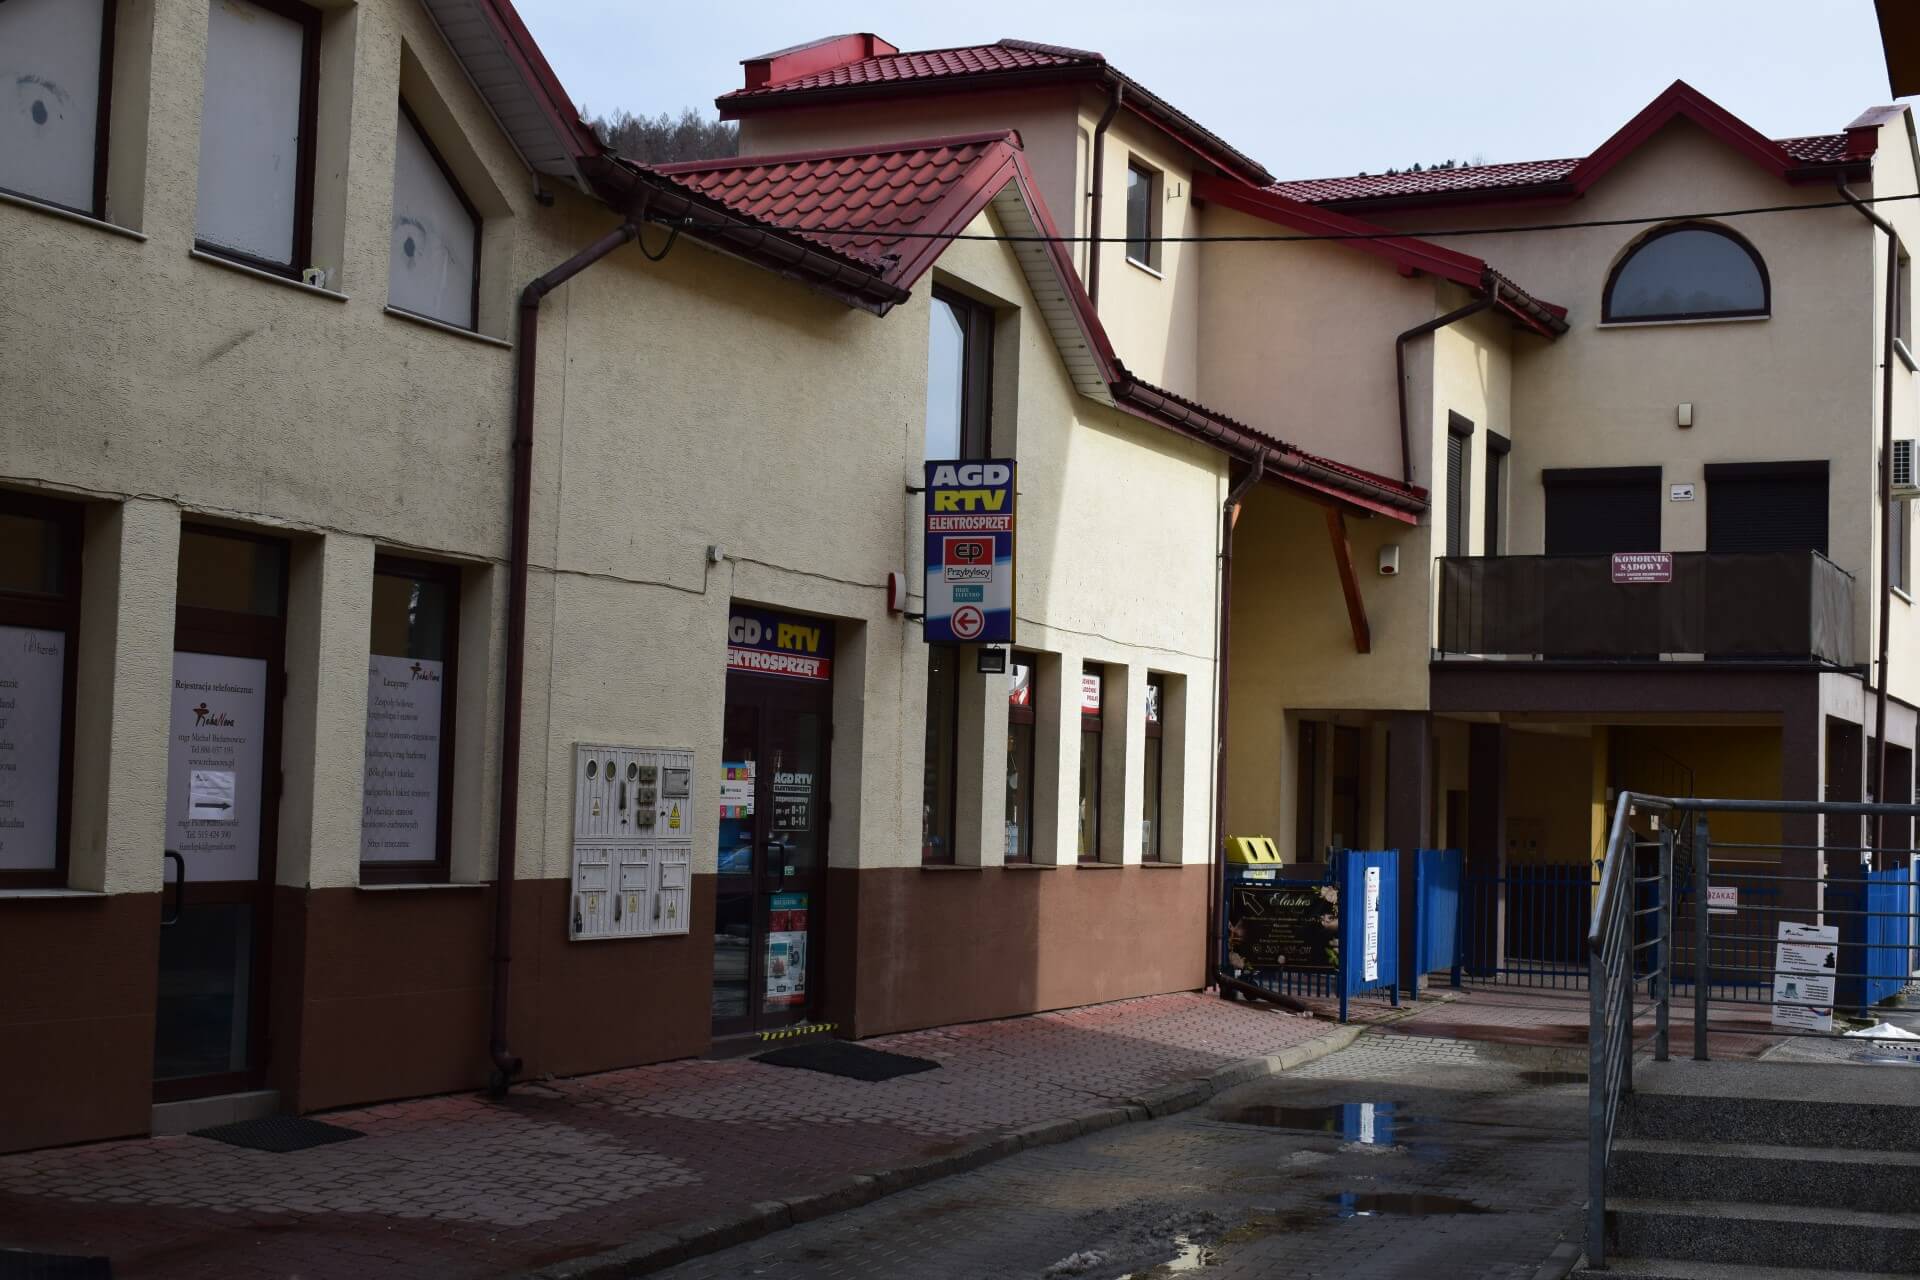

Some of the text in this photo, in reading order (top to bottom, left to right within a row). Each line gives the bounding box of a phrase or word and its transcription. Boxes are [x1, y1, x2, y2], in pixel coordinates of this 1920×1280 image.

[931, 464, 1010, 487] AGD
[934, 489, 1007, 512] RTV
[929, 516, 1011, 532] ELEKTROSPRZĘT
[1614, 555, 1669, 563] KOMORNIK
[947, 567, 990, 578] Przybylscy
[1619, 563, 1663, 572] SĄDOWY
[777, 623, 821, 653] RTV
[175, 679, 211, 693] Rejestracja
[774, 771, 813, 785] AGD RTV
[1711, 891, 1735, 900] ZAKAZ
